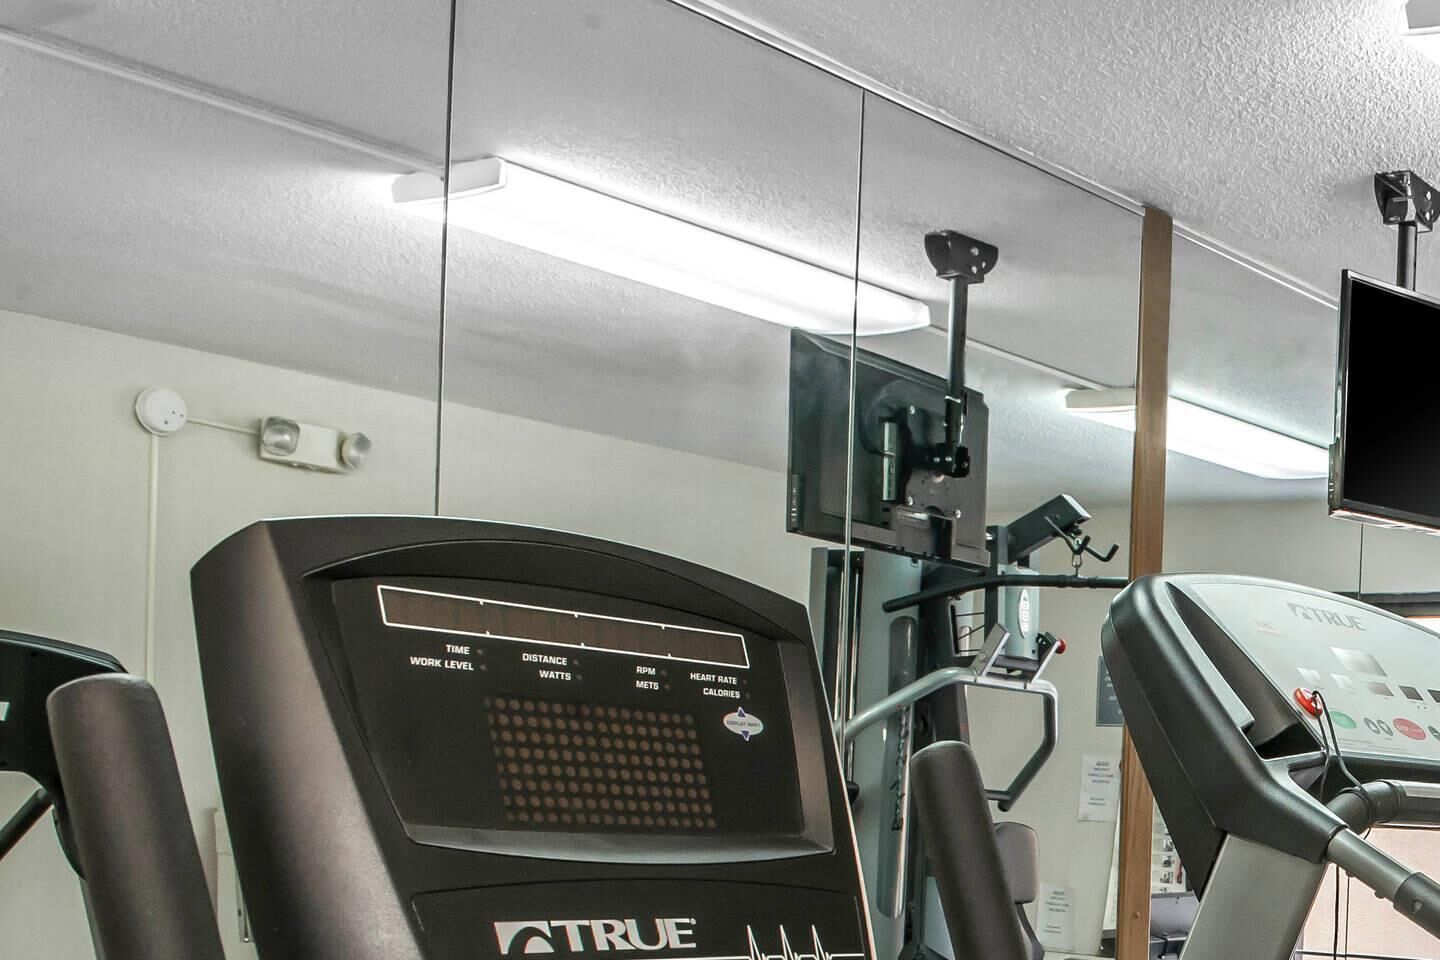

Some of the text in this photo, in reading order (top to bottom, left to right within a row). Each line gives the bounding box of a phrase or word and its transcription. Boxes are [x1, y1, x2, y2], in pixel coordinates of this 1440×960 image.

[1305, 606, 1367, 632] TRUE
[445, 644, 470, 655] TIME
[410, 656, 475, 671] WORK LEVEL
[522, 653, 568, 666] DISTANCE
[539, 670, 572, 681] WATTS
[636, 666, 656, 675] RPM
[690, 672, 738, 685] HEART RATE
[636, 680, 659, 690] METS
[703, 687, 741, 699] CALORIES
[550, 918, 697, 952] TRUE
